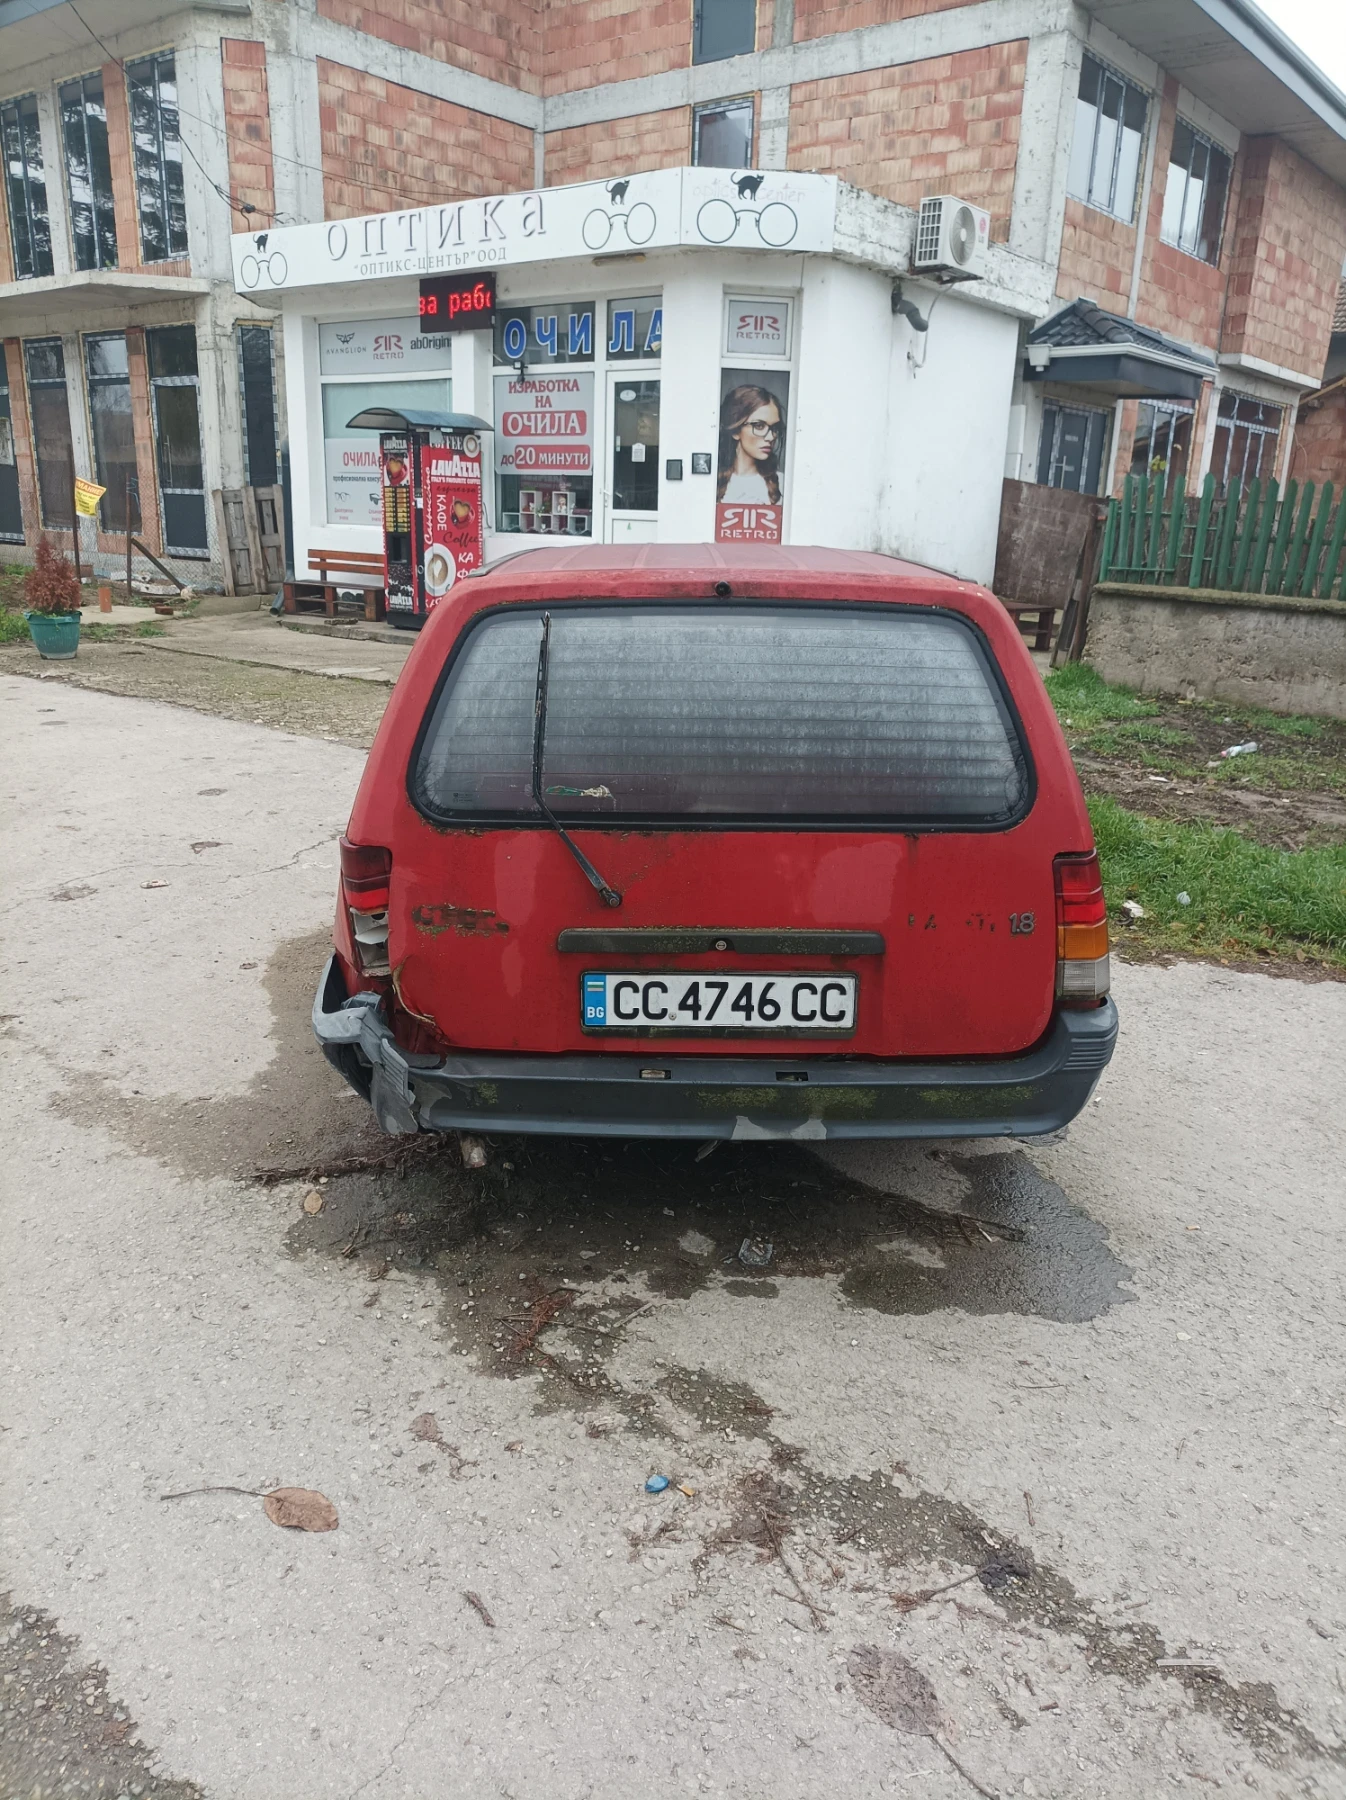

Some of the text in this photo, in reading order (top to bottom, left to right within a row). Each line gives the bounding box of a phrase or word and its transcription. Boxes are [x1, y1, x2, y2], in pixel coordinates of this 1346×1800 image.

[503, 307, 662, 359] ОЧИЛА
[736, 331, 781, 340] RETRO
[508, 378, 580, 394] ИЗРАБОТКА
[535, 395, 552, 409] НА
[507, 412, 582, 435] ОЧИЛА
[343, 451, 378, 467] ОЧИЛА
[500, 454, 515, 467] до
[515, 447, 536, 465] 20
[436, 494, 447, 531] КАФЕ
[720, 529, 778, 539] RETRO
[1008, 912, 1035, 933] 1.8
[678, 981, 781, 1021] 4746
[586, 1006, 605, 1018] BG
